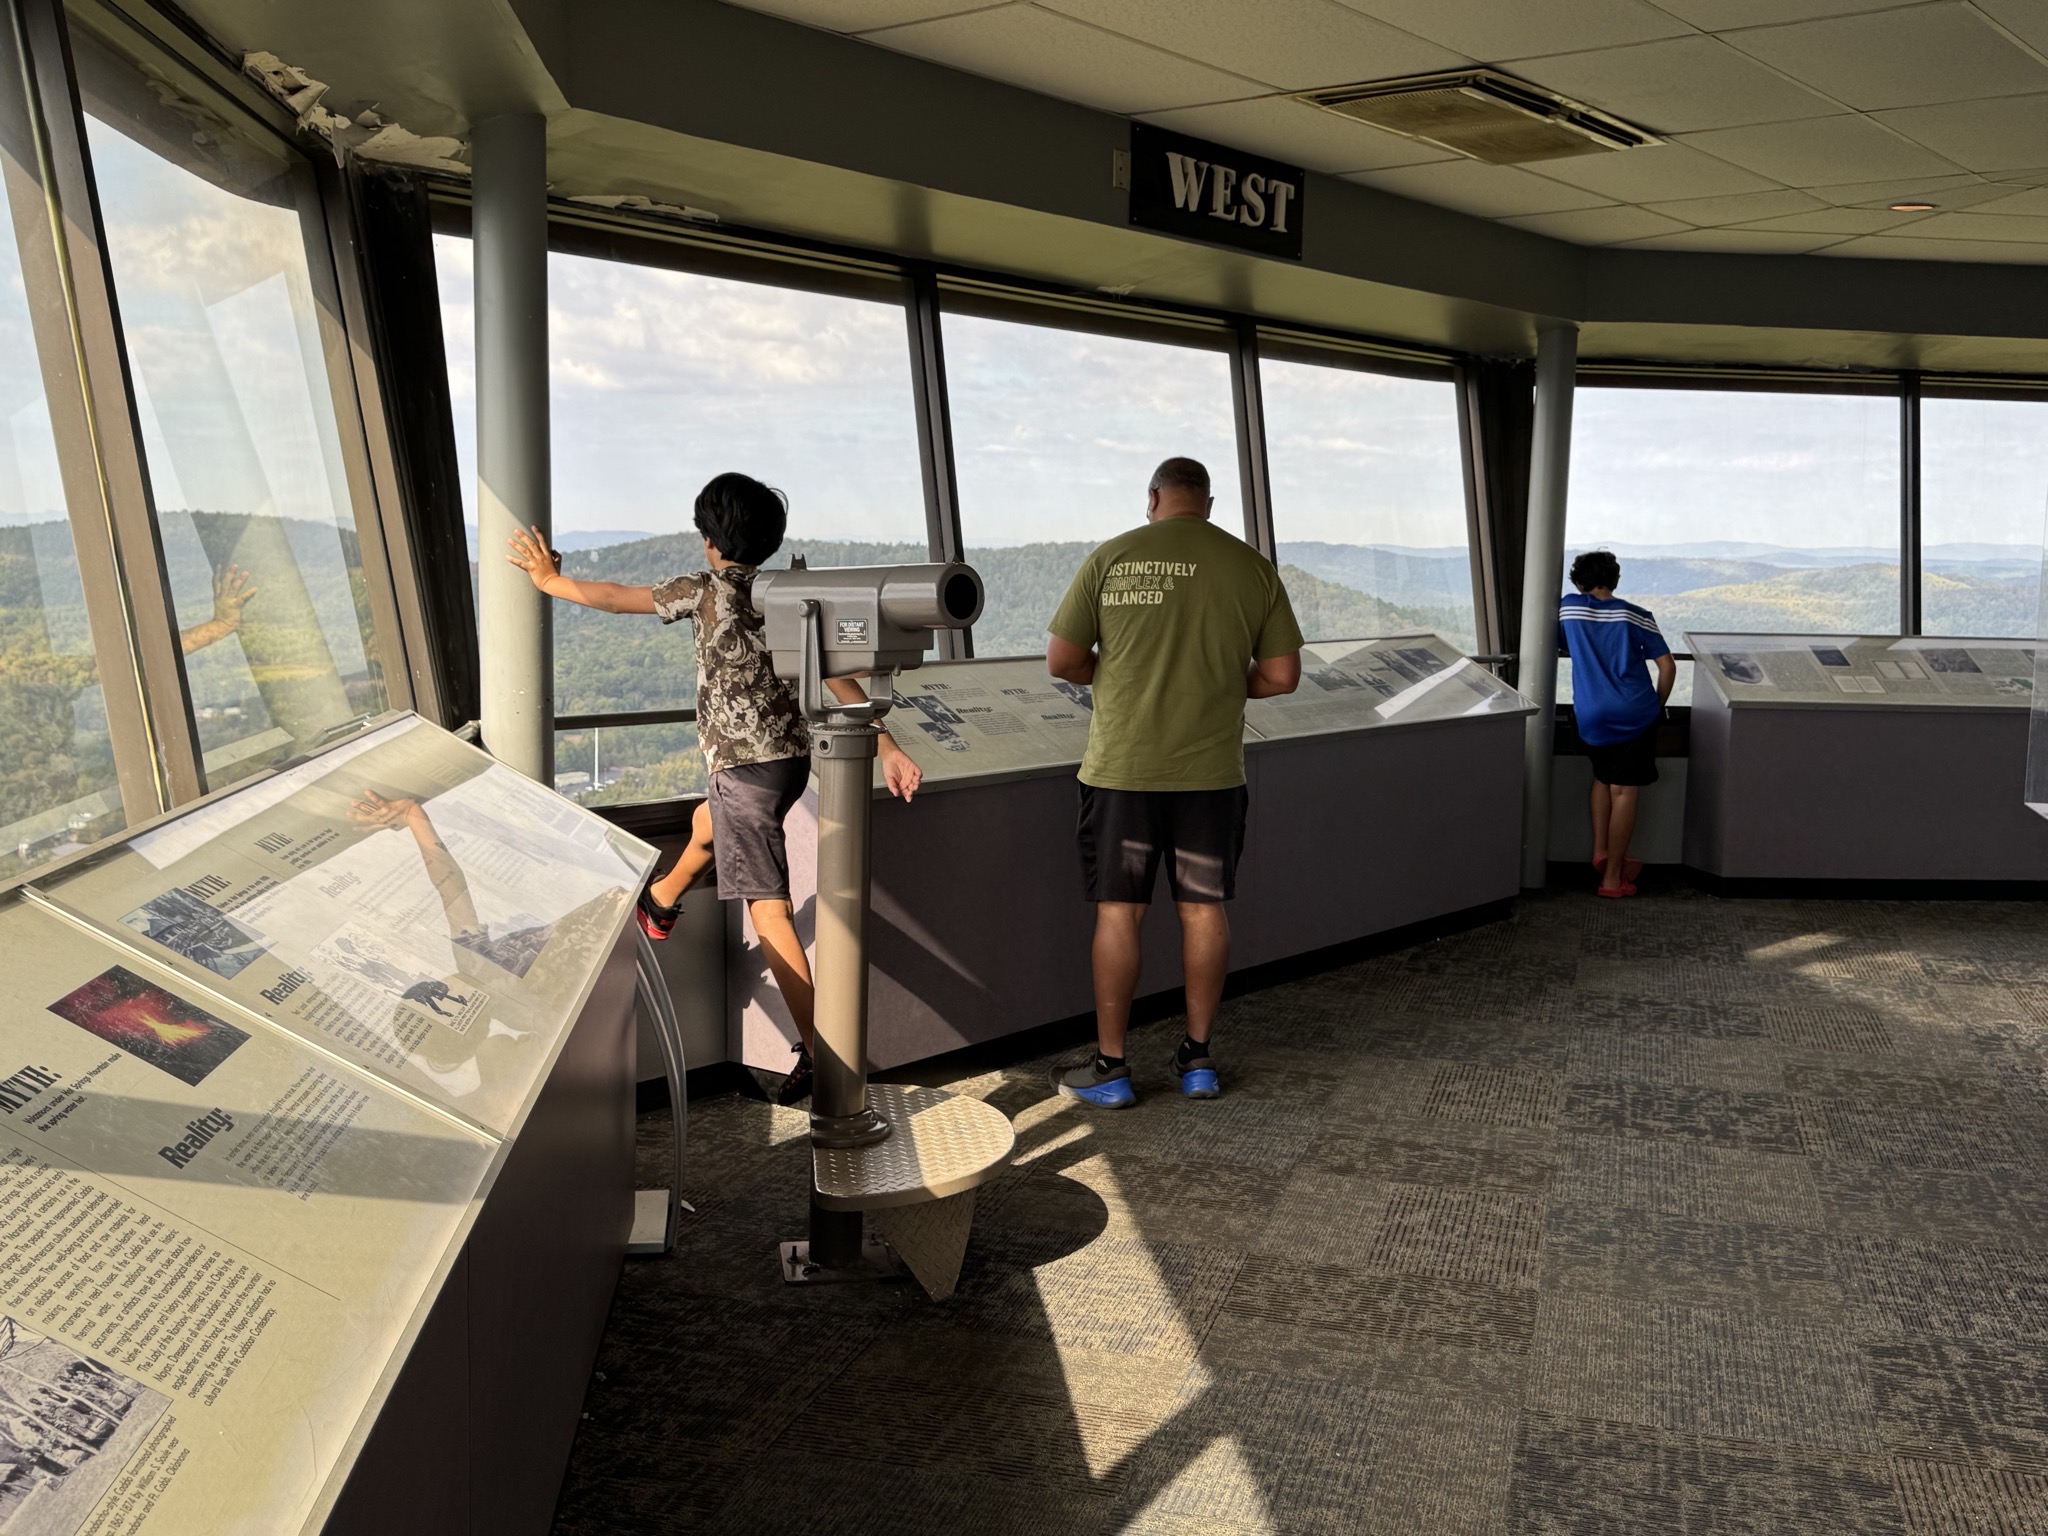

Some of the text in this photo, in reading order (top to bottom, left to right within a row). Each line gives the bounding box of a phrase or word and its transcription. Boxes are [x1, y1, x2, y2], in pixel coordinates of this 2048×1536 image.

[1165, 151, 1295, 233] WEST
[1103, 575, 1175, 591] COMPLEX &
[1101, 590, 1164, 606] BALANCED
[254, 831, 294, 854] MYTH:
[183, 874, 233, 901] MYTH:
[319, 871, 363, 898] Reality:
[259, 966, 316, 1006] Reality:
[0, 1065, 63, 1115] MYTH:
[22, 1052, 122, 1125] Volcanoes under Hot Springs Mountain make
[37, 1123, 52, 1133] the
[47, 1111, 68, 1126] spring
[61, 1101, 78, 1114] water
[157, 1107, 235, 1170] Reality:
[147, 1228, 159, 1238] use
[152, 1221, 166, 1231] the
[138, 1234, 152, 1246] did
[177, 1236, 193, 1247] how
[198, 1242, 206, 1250] or
[6, 1295, 24, 1309] their
[17, 1274, 47, 1298] territories.
[38, 1261, 58, 1275] Their
[53, 1240, 83, 1264] well-being
[75, 1230, 89, 1243] and
[96, 1197, 123, 1221] depended
[123, 1244, 145, 1260] Caddo
[168, 1244, 185, 1259] about
[183, 1248, 203, 1268] evidence
[25, 1206, 137, 1317] on reliable sources of food and raw materials for
[41, 1212, 152, 1325] making everything from turkey-feather head
[116, 1259, 131, 1269] the
[158, 1257, 175, 1270] clues
[217, 1264, 232, 1273] by
[222, 1257, 235, 1267] the
[153, 1267, 167, 1279] any
[237, 1265, 249, 1275] one
[71, 1317, 97, 1342] thermal
[112, 1290, 124, 1300] no
[119, 1262, 147, 1289] traditional
[158, 1228, 180, 1245] historic
[95, 1272, 119, 1290] houses.
[142, 1275, 158, 1286] left
[160, 1263, 189, 1295] archeological
[222, 1273, 245, 1291] holding
[243, 1272, 263, 1294] mountain
[88, 1286, 103, 1301] reed
[132, 1284, 151, 1298] have
[204, 1284, 215, 1292] as
[219, 1286, 231, 1300] and
[79, 1299, 92, 1308] to
[151, 1292, 166, 1303] No
[233, 1298, 244, 1307] on
[235, 1291, 249, 1301] the
[119, 1250, 222, 1366] Native American oral history supports such stories as
[120, 1295, 142, 1315] artifacts
[186, 1293, 206, 1315] referred
[223, 1302, 239, 1319] stood
[58, 1305, 87, 1333] ornaments
[115, 1313, 125, 1322] or
[135, 1307, 154, 1321] done
[123, 1319, 143, 1333] have
[193, 1317, 209, 1332] white
[215, 1316, 230, 1328] she
[116, 1329, 133, 1347] might
[160, 1334, 175, 1345] the
[181, 1336, 195, 1344] in
[187, 1327, 200, 1339] all
[187, 1369, 215, 1399] overseeing
[204, 1361, 218, 1371] the
[223, 1332, 239, 1343] The
[231, 1316, 250, 1335] Mayan
[257, 1284, 272, 1297] had
[267, 1279, 277, 1288] no
[104, 1344, 124, 1358] they
[156, 1340, 168, 1351] of
[166, 1339, 190, 1364] Dressed
[199, 1338, 214, 1353] each
[233, 1335, 257, 1359] Caddoan
[145, 1347, 166, 1363] Lady
[191, 1351, 205, 1359] in
[227, 1357, 242, 1368] the
[151, 1362, 176, 1383] Mayan.
[178, 1355, 200, 1376] feather
[222, 1365, 236, 1378] with
[171, 1374, 188, 1391] eagle
[214, 1376, 229, 1388] ties
[203, 1383, 222, 1407] cultural
[167, 1436, 179, 1451] near
[113, 1476, 134, 1496] Caddo
[126, 1447, 153, 1478] farmstead
[135, 1469, 157, 1491] William
[142, 1498, 155, 1514] and
[165, 1448, 191, 1476] Oklahoma
[129, 1489, 145, 1500] by
